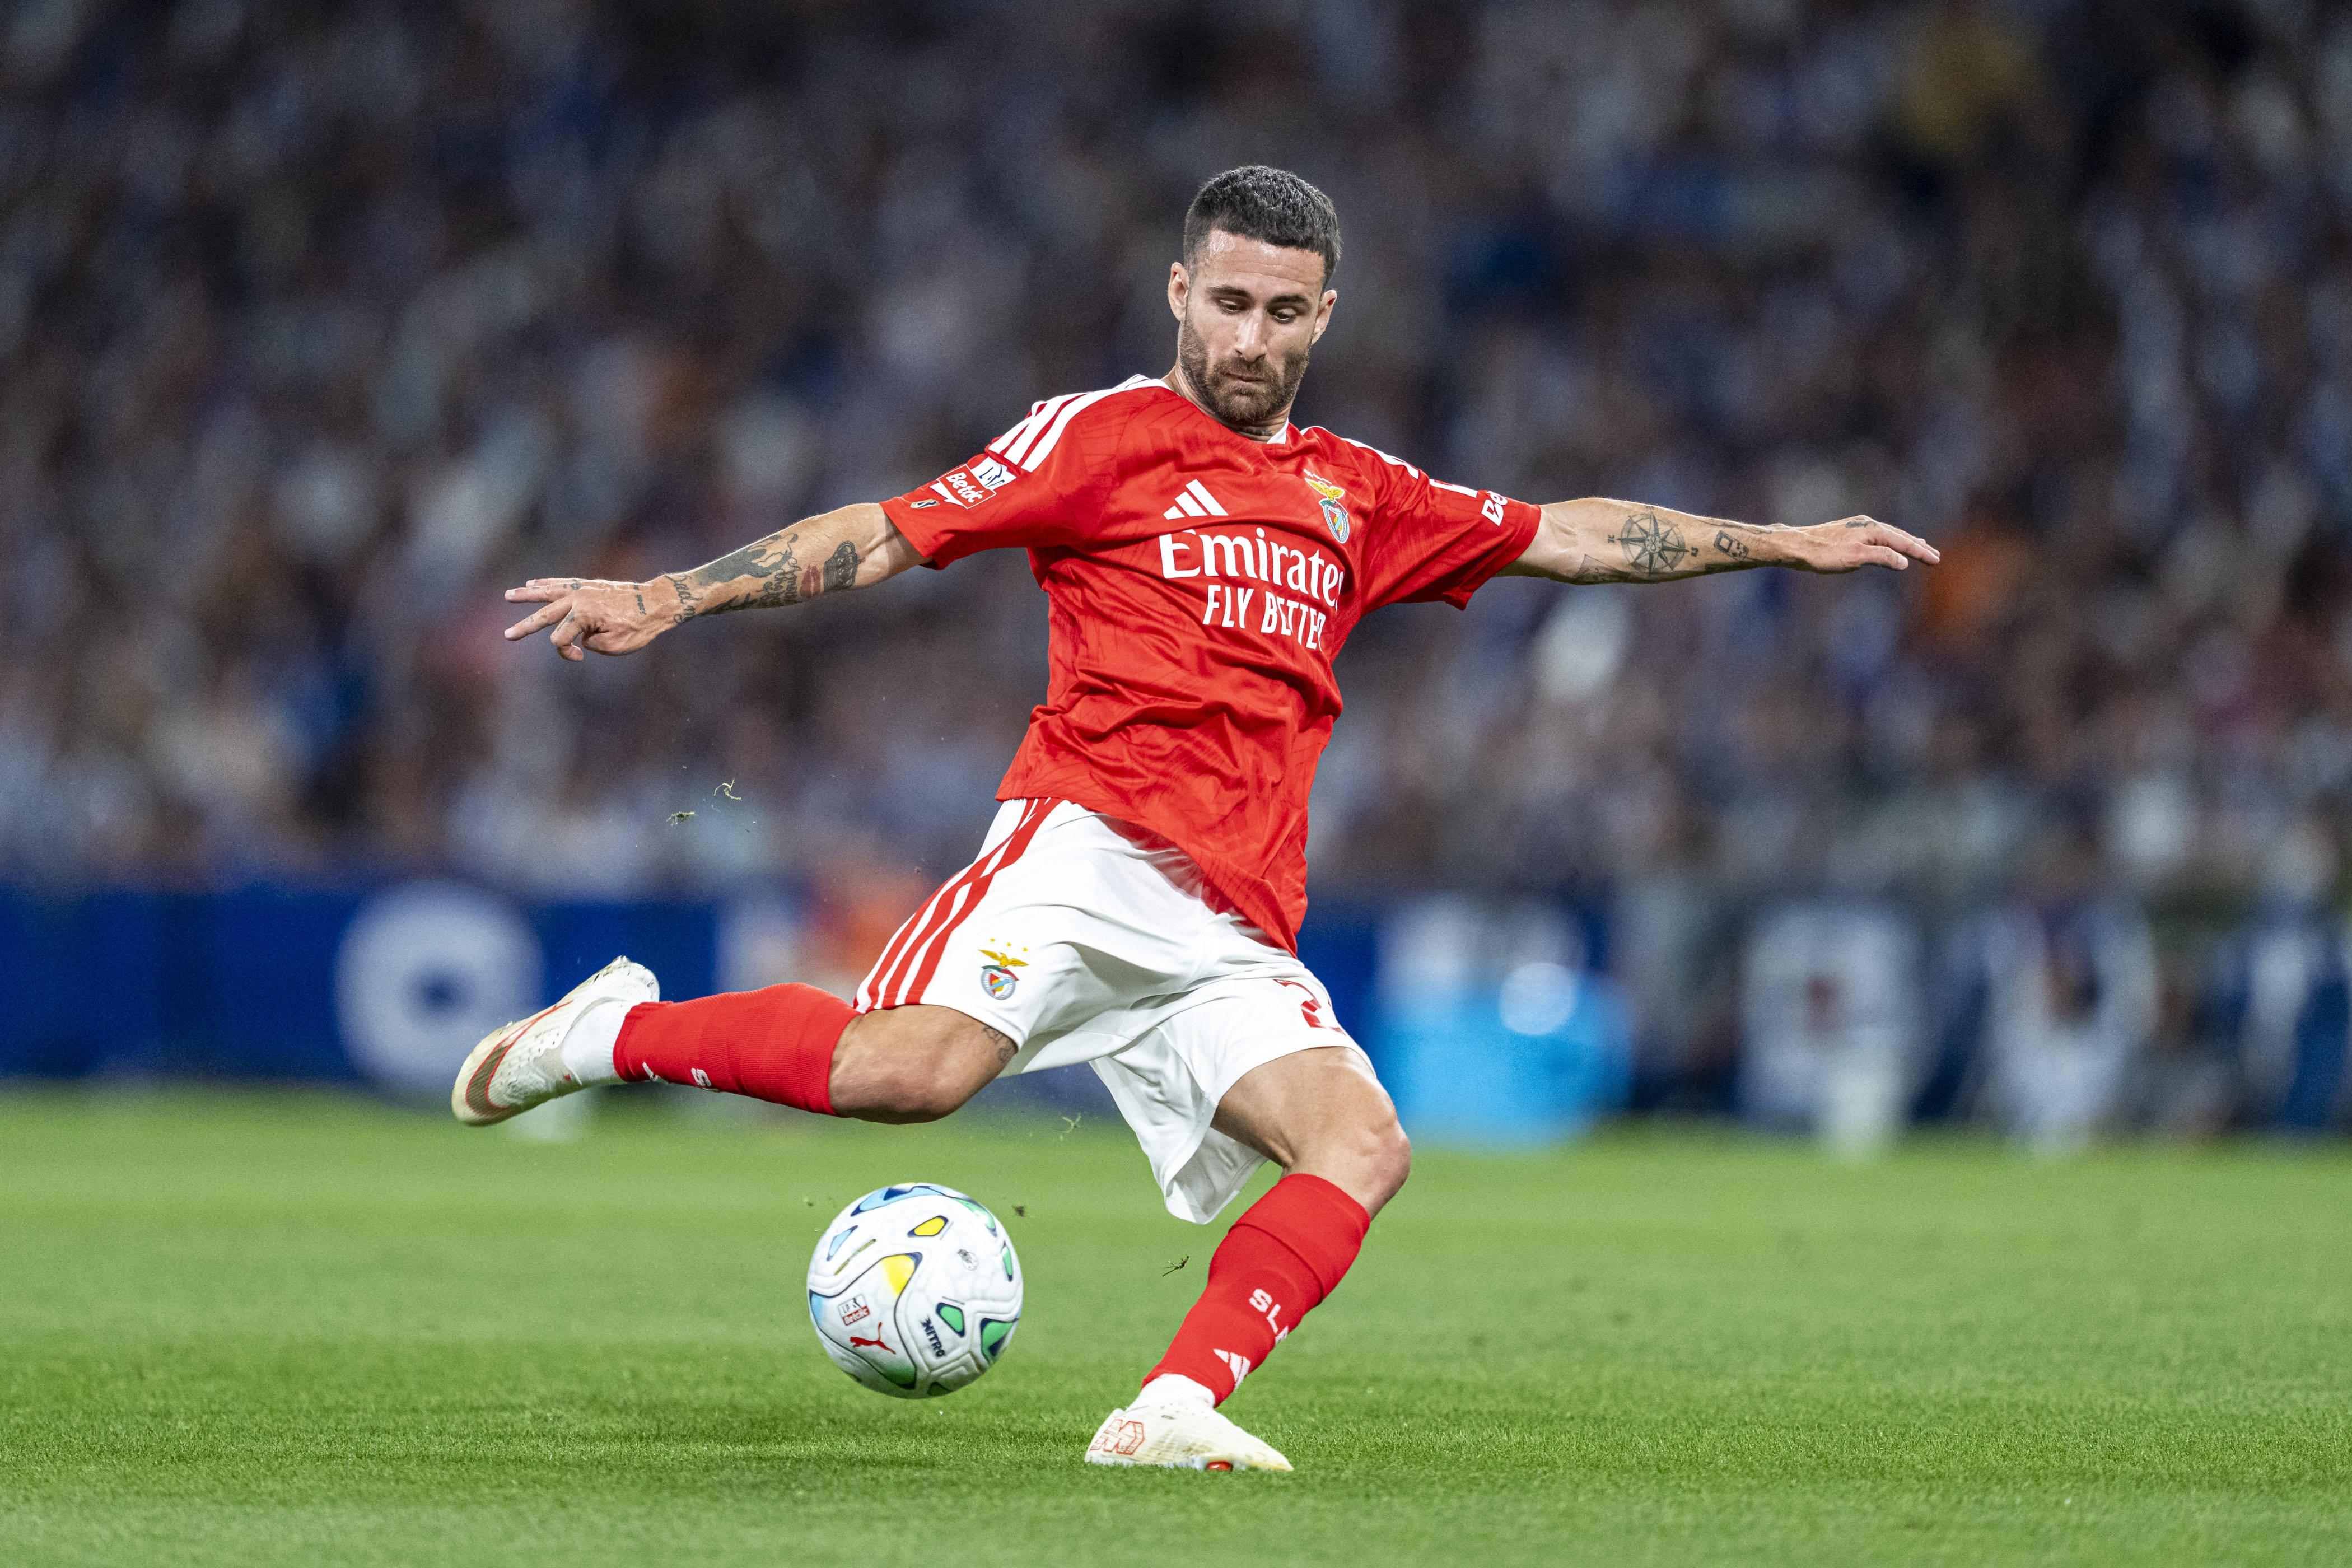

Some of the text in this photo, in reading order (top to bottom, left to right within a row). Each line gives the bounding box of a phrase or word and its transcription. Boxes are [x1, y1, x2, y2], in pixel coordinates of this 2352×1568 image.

[1481, 491, 1508, 527] Be
[1202, 584, 1255, 629] FLY
[920, 1315, 946, 1358] NITRO
